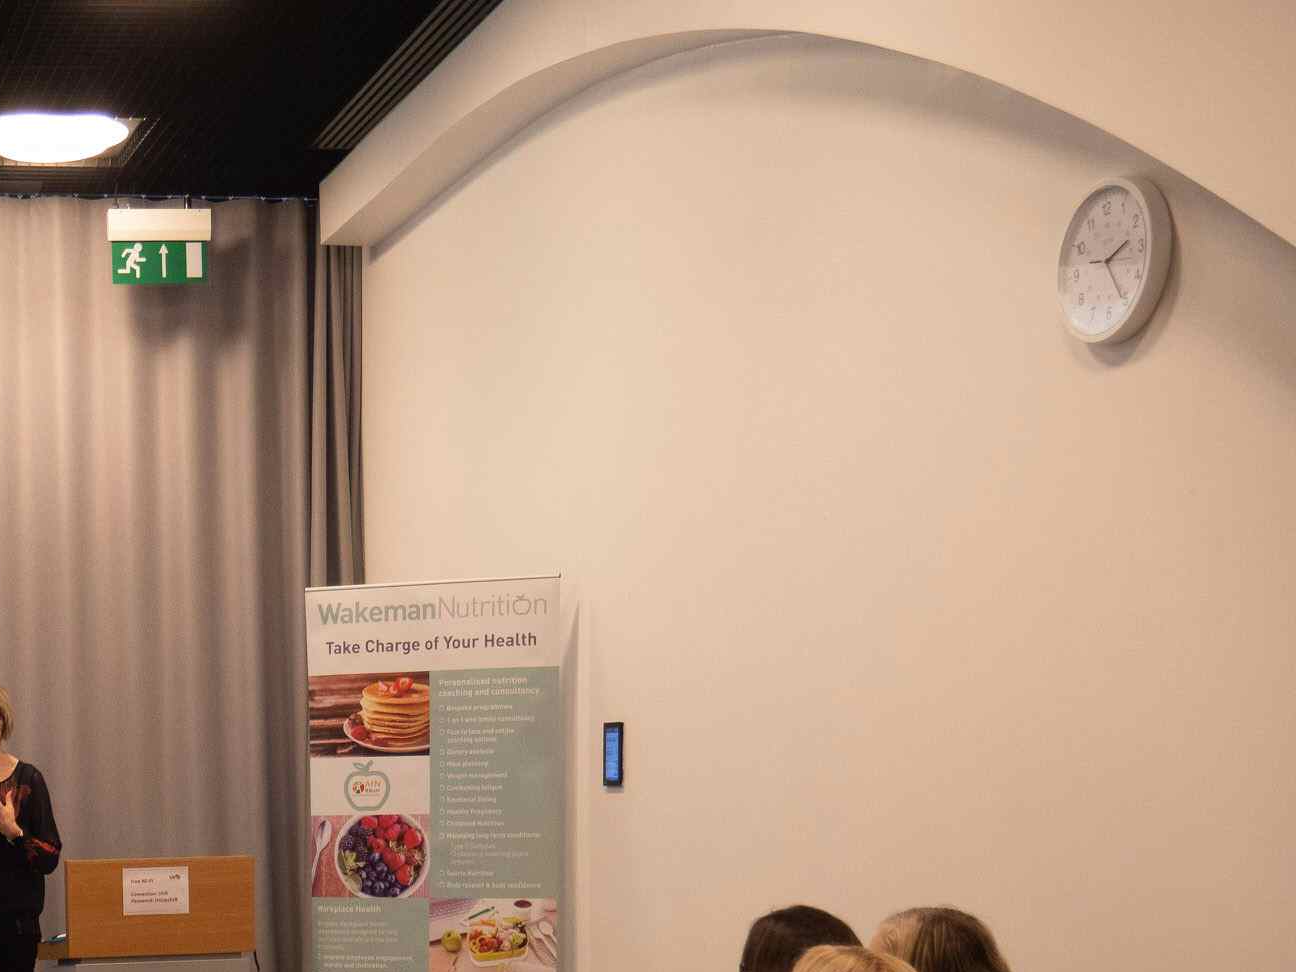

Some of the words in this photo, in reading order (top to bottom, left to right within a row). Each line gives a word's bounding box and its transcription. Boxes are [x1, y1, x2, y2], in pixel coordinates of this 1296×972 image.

[326, 641, 360, 655] Take
[365, 638, 420, 655] Charge
[425, 636, 439, 650] of
[443, 635, 479, 650] Your
[484, 632, 537, 648] Health
